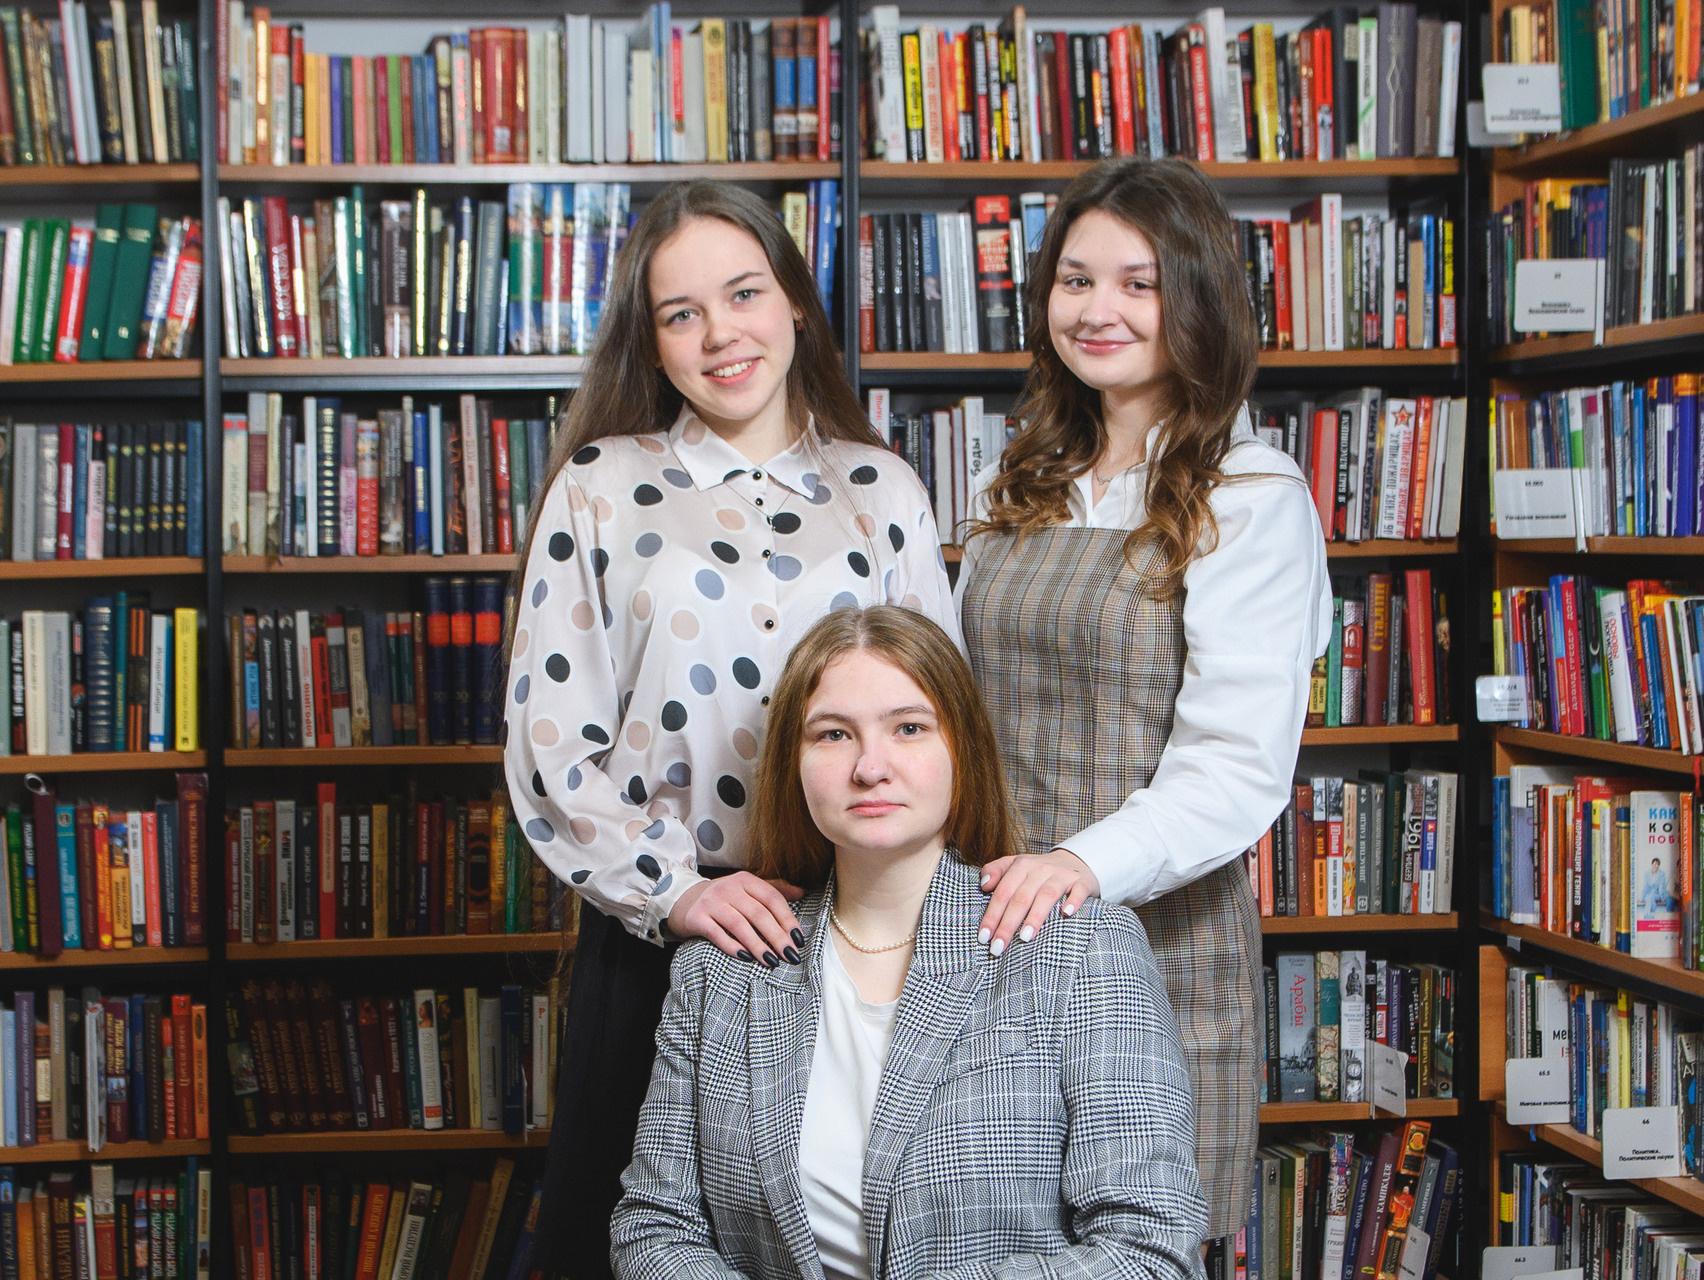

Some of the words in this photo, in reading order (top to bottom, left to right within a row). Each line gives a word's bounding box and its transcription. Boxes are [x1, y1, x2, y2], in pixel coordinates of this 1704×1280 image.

[1367, 398, 1378, 442] КНИГА
[1339, 415, 1349, 470] ВЛАСОВЦЕМ
[1338, 495, 1346, 503] Я
[1339, 472, 1347, 493] БЫЛ
[1363, 447, 1374, 529] БЛОКАДНАЯ
[1383, 525, 1394, 535] ОБ
[1369, 582, 1384, 651] Сталин
[1566, 590, 1574, 620] ДОЛГ
[1604, 621, 1614, 676] ЛОГИСТИКИ
[1610, 618, 1619, 659] ОСНОВЫ
[1570, 672, 1578, 710] ДЭВИД
[1408, 815, 1422, 851] 1961
[1648, 808, 1677, 819] КАК
[1648, 822, 1679, 833] КО
[281, 830, 292, 859] ПИАРА
[1574, 819, 1582, 872] КОРПОРАЦИЯ
[1404, 853, 1412, 881] БЕРЛИН
[1289, 973, 1308, 1028] Арабы
[1296, 1168, 1304, 1197] ОДЕССА
[1376, 1163, 1392, 1213] КАМИКАДЗЕ
[1354, 1204, 1365, 1229] ФИДЕЛЬ
[1360, 1179, 1368, 1203] КАСТРО
[151, 1212, 162, 1259] МАРГАРИТЫ
[166, 1212, 176, 1259] МАРГАРИТЫ
[403, 1220, 420, 1258] РАСПУТИН
